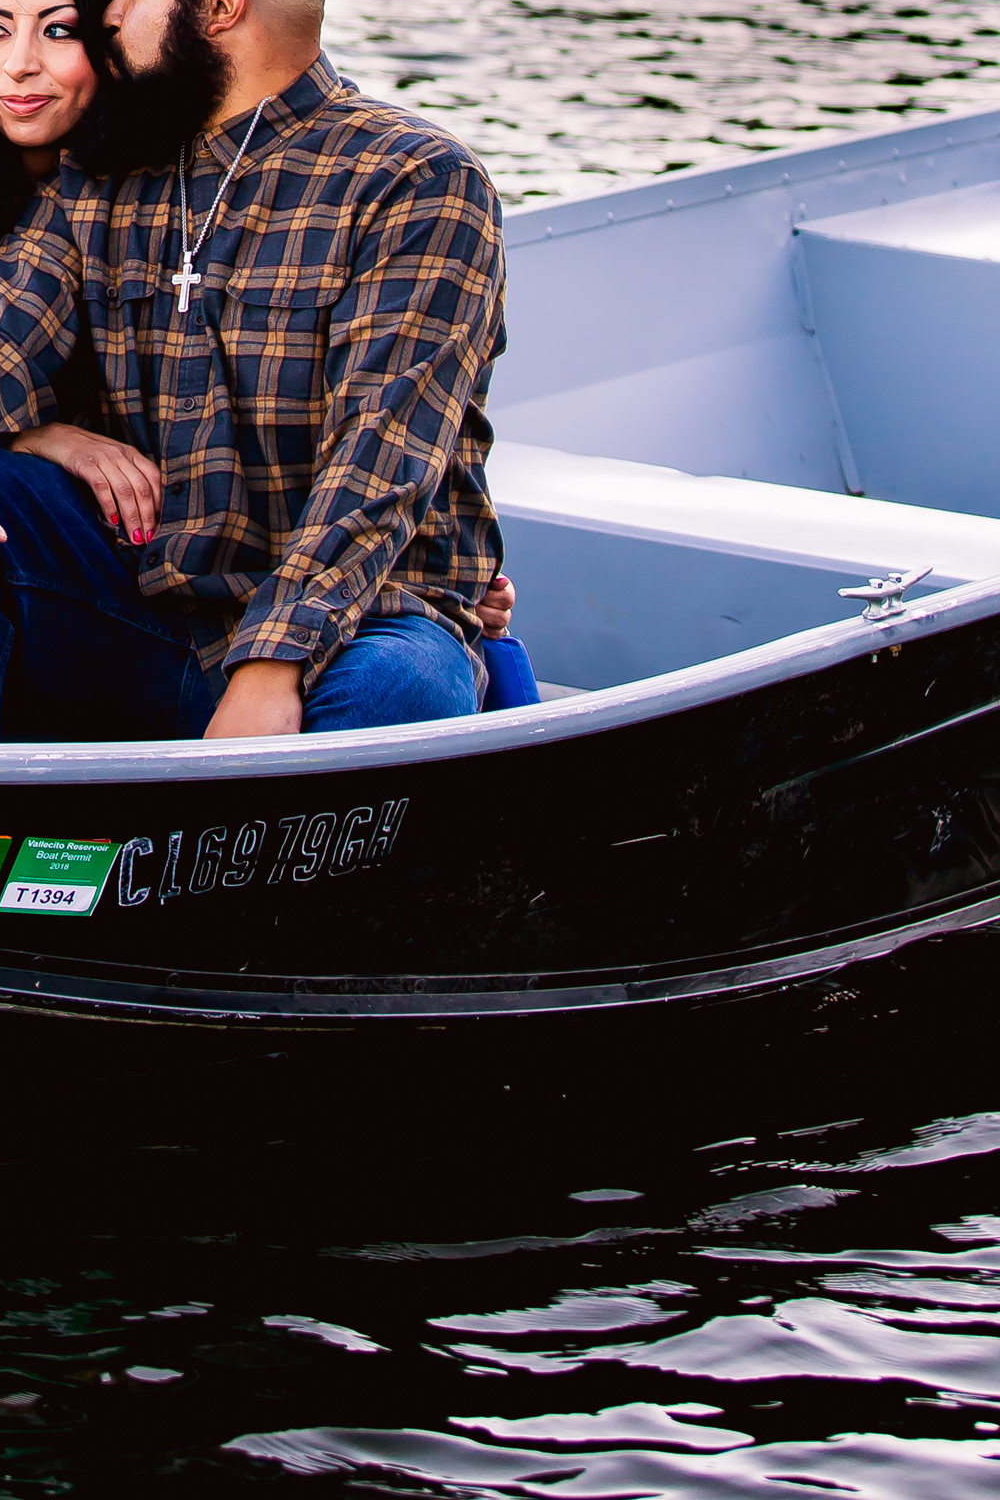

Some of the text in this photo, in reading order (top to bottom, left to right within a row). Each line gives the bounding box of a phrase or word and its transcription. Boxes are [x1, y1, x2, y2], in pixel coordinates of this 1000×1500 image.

[28, 839, 110, 852] Vallecito Reservoir
[35, 850, 92, 862] Boat Permit
[49, 862, 70, 870] 2018
